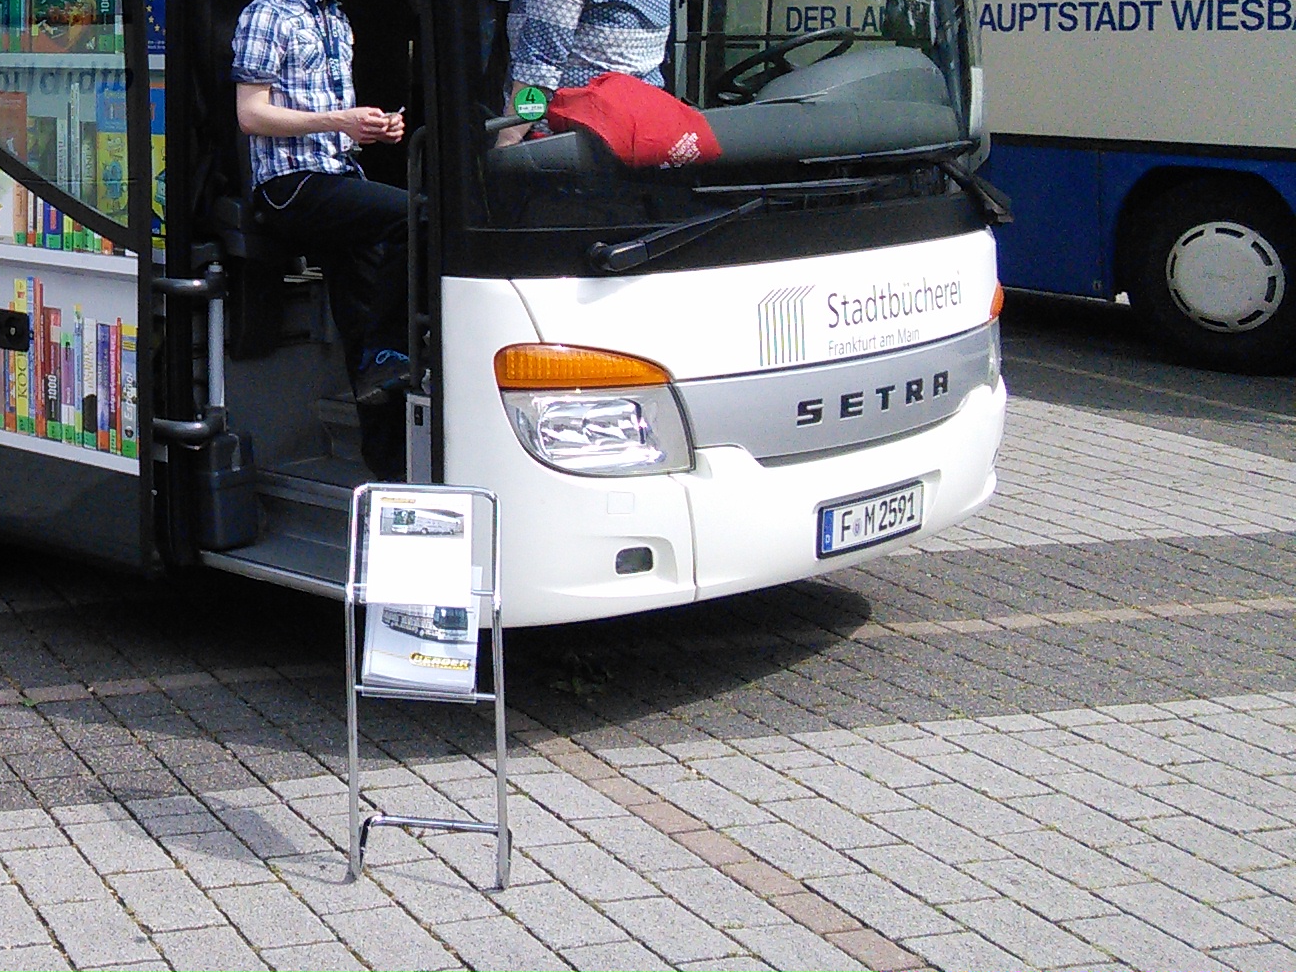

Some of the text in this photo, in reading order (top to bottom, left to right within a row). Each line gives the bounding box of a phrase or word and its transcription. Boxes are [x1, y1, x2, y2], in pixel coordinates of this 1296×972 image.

[786, 5, 837, 33] DER
[525, 88, 536, 104] 4
[827, 270, 962, 329] Stadtbücherei
[828, 327, 920, 357] Frankfurt am Main
[17, 352, 28, 399] KOC
[48, 373, 57, 400] 1000
[796, 370, 949, 427] SETRA
[840, 510, 853, 542] F
